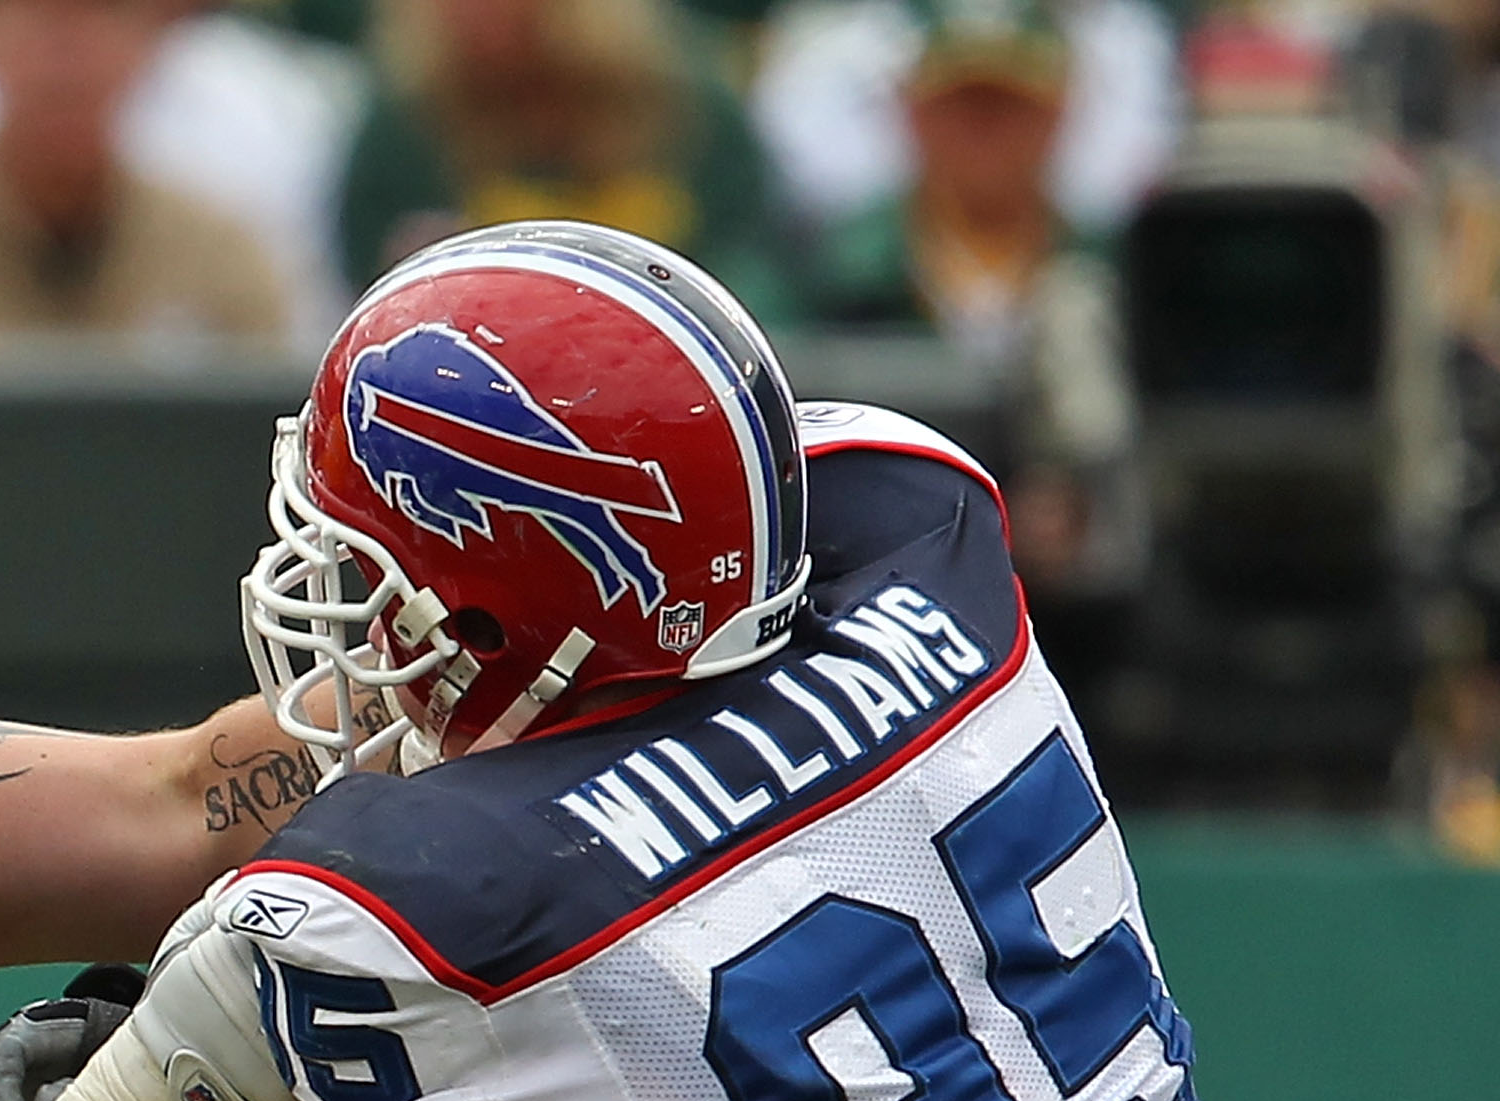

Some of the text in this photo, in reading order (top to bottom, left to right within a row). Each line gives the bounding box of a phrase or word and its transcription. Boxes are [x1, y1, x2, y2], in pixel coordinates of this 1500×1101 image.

[710, 551, 743, 584] 95
[664, 621, 699, 647] NFL
[551, 583, 991, 884] WILLIAMS
